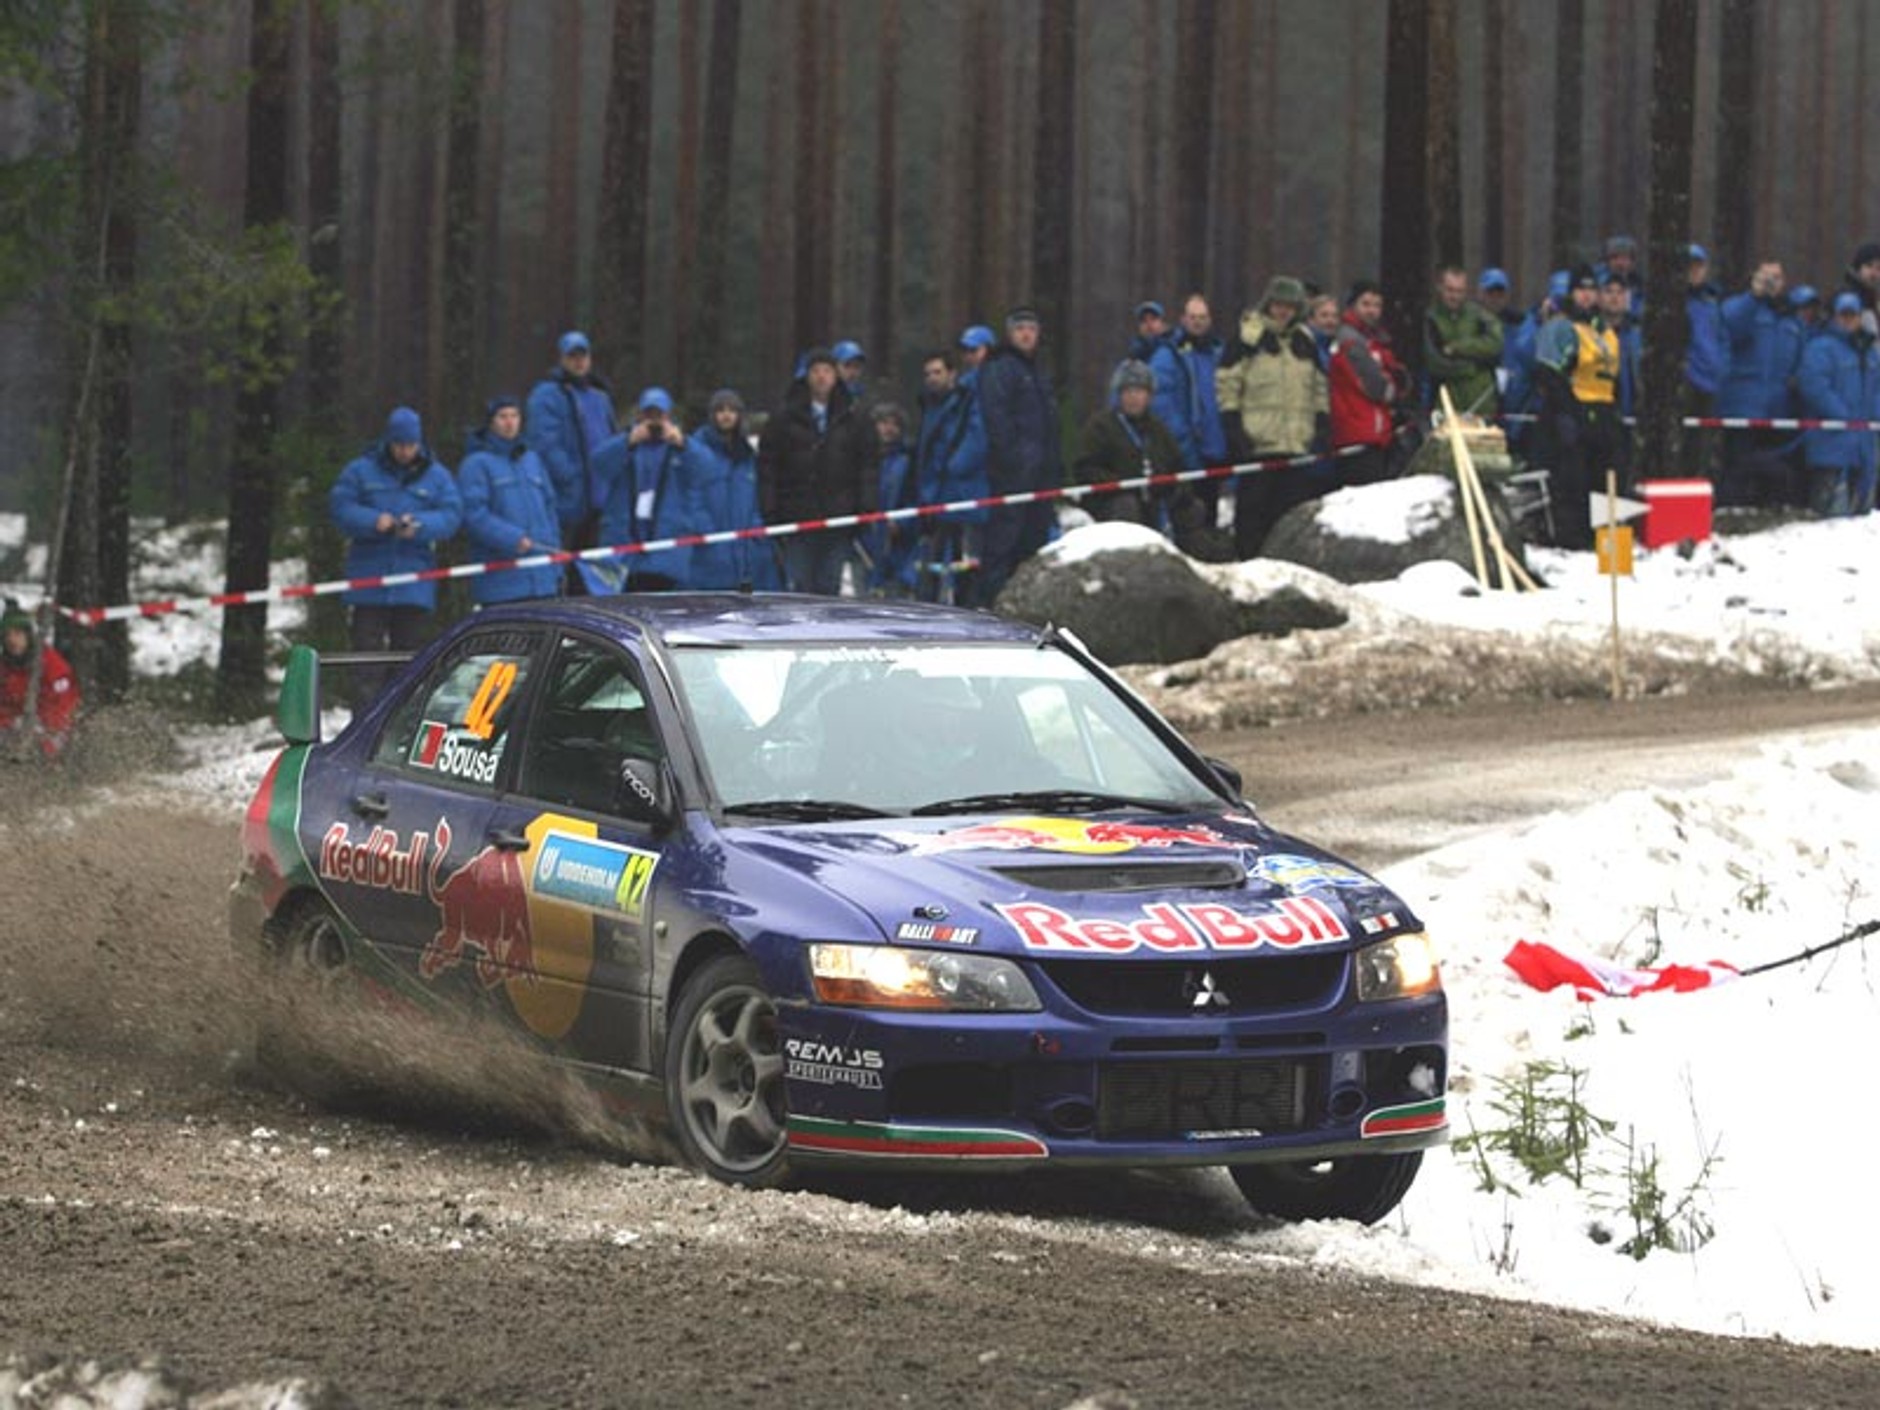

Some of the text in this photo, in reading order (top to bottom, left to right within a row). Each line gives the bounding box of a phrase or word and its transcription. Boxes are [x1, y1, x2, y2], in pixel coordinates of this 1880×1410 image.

[439, 732, 499, 783] Sousa
[320, 822, 429, 895] Red Bull
[999, 902, 1205, 953] Red
[1180, 896, 1349, 950] Bull
[784, 1039, 884, 1069] REMUS
